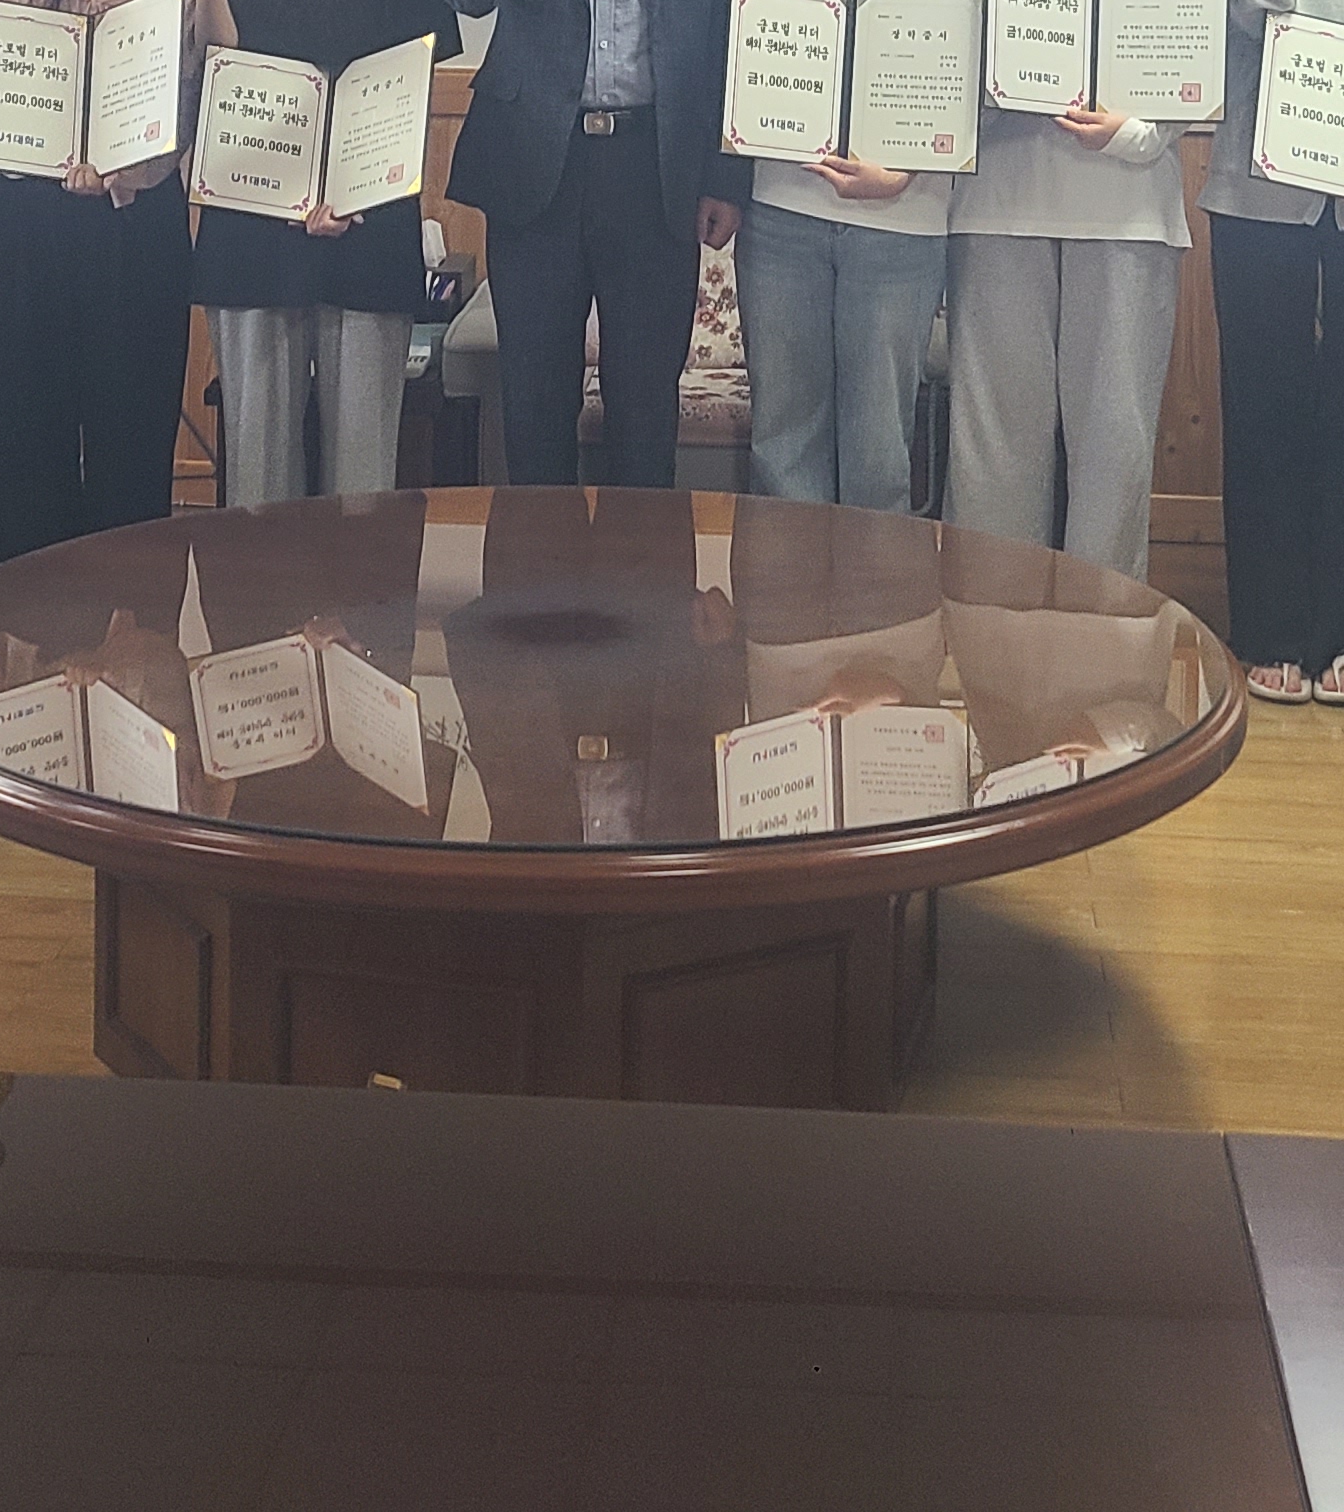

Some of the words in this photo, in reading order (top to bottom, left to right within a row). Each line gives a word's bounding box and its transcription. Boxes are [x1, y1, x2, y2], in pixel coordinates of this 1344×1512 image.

[798, 24, 819, 40] 리더
[1006, 25, 1075, 46] 금1,000,000원
[35, 47, 58, 62] 리더
[747, 72, 824, 94] 금1,000,000원
[276, 93, 299, 109] 리더
[219, 131, 302, 156] 금1,000,000원
